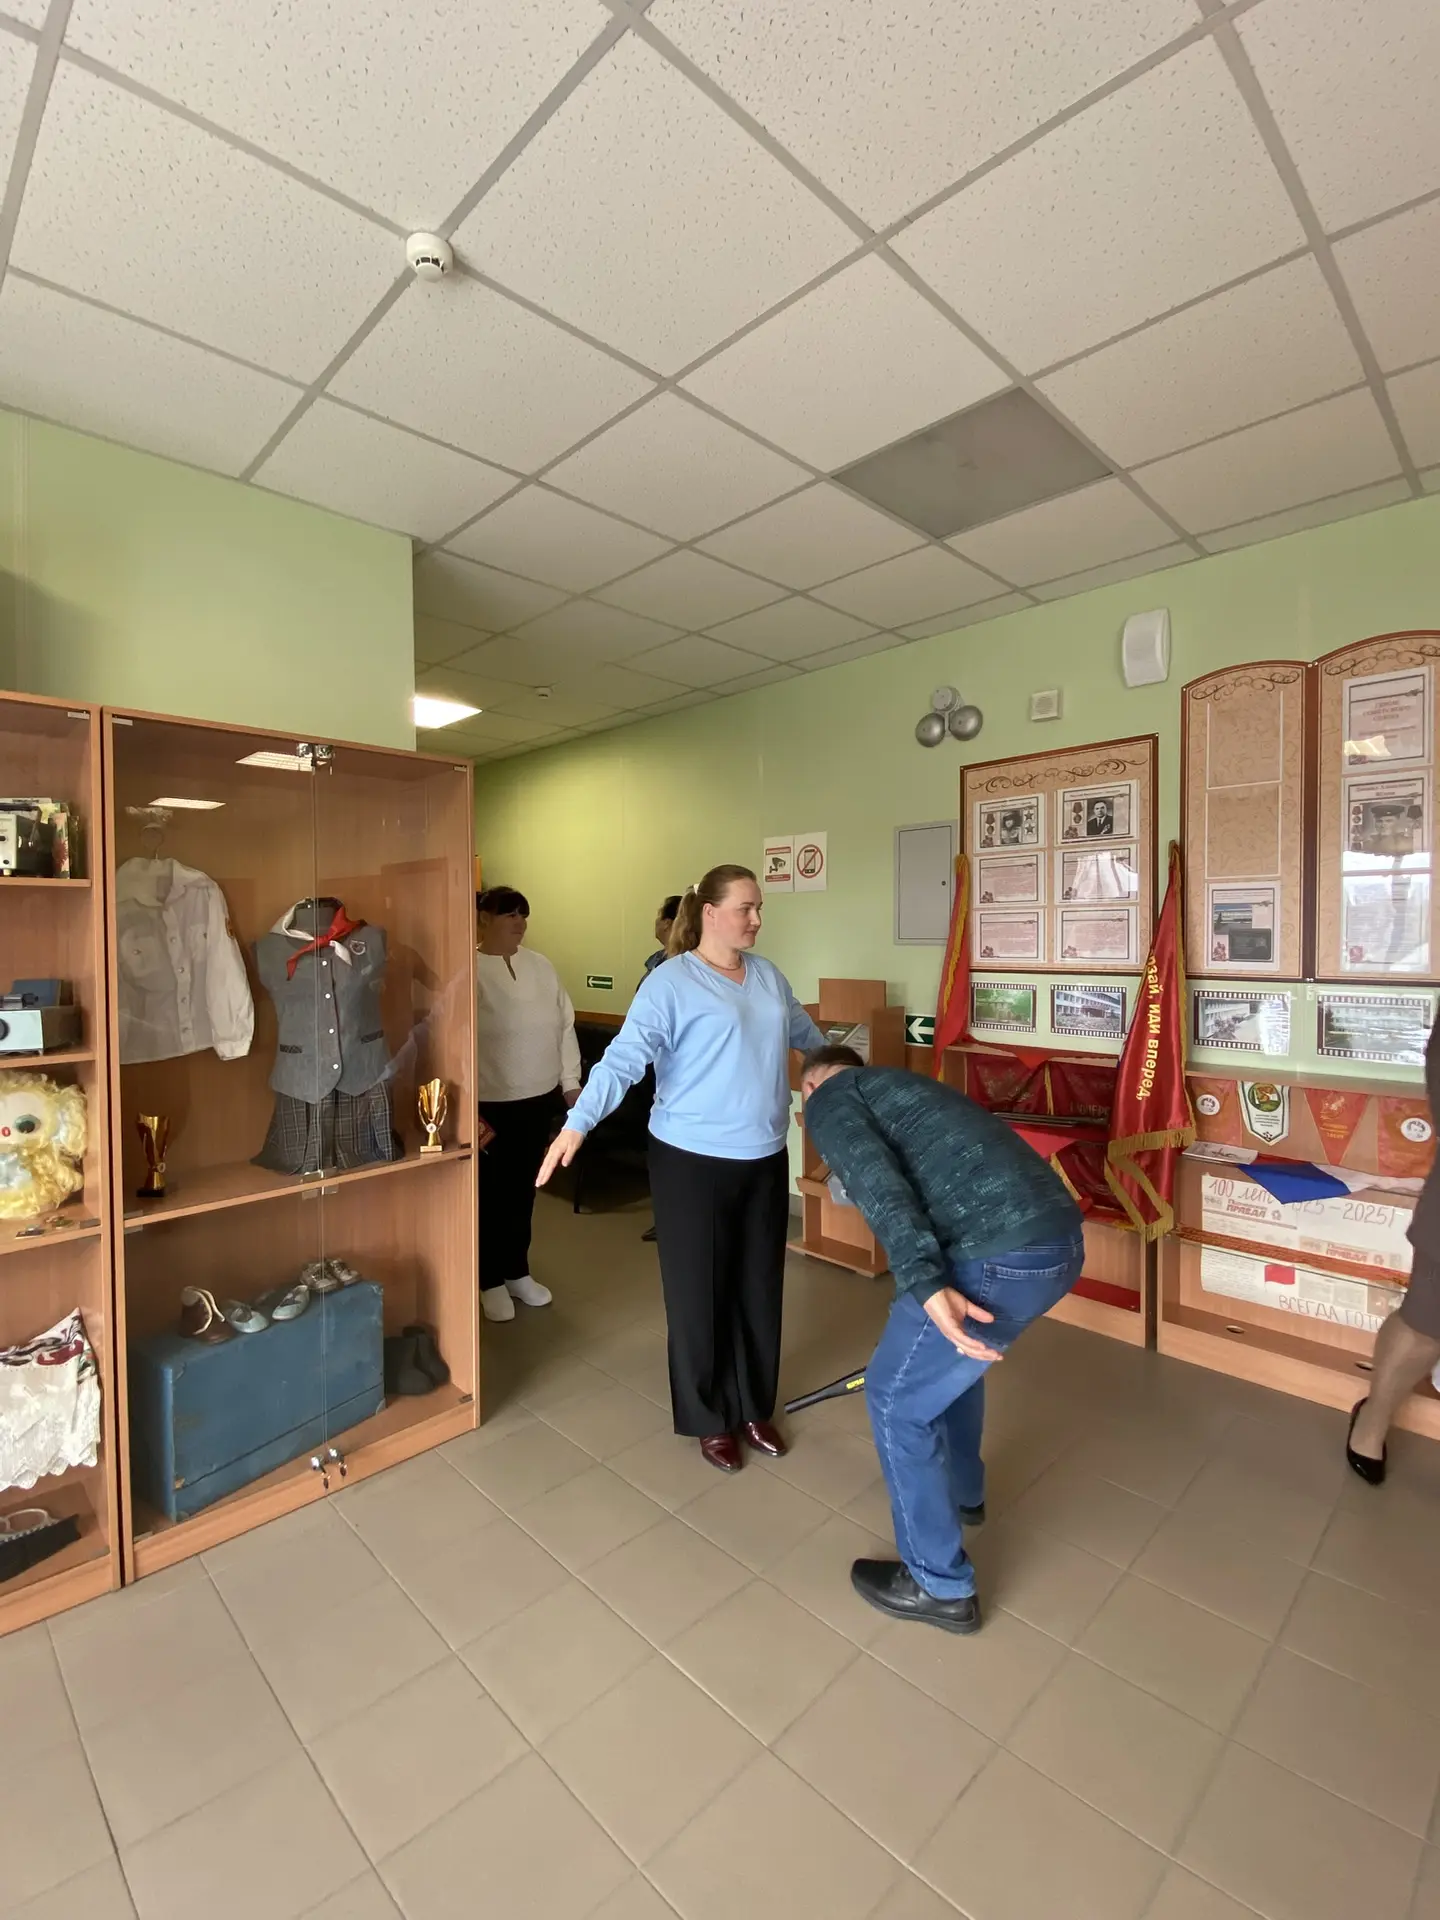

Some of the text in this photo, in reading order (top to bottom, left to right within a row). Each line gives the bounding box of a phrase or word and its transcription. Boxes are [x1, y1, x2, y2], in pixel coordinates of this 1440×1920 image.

[1136, 954, 1164, 1100] рзай, иди вперед,
[1209, 1179, 1234, 1199] 100
[1278, 1294, 1385, 1331] ВСЕГДА ГОТО
